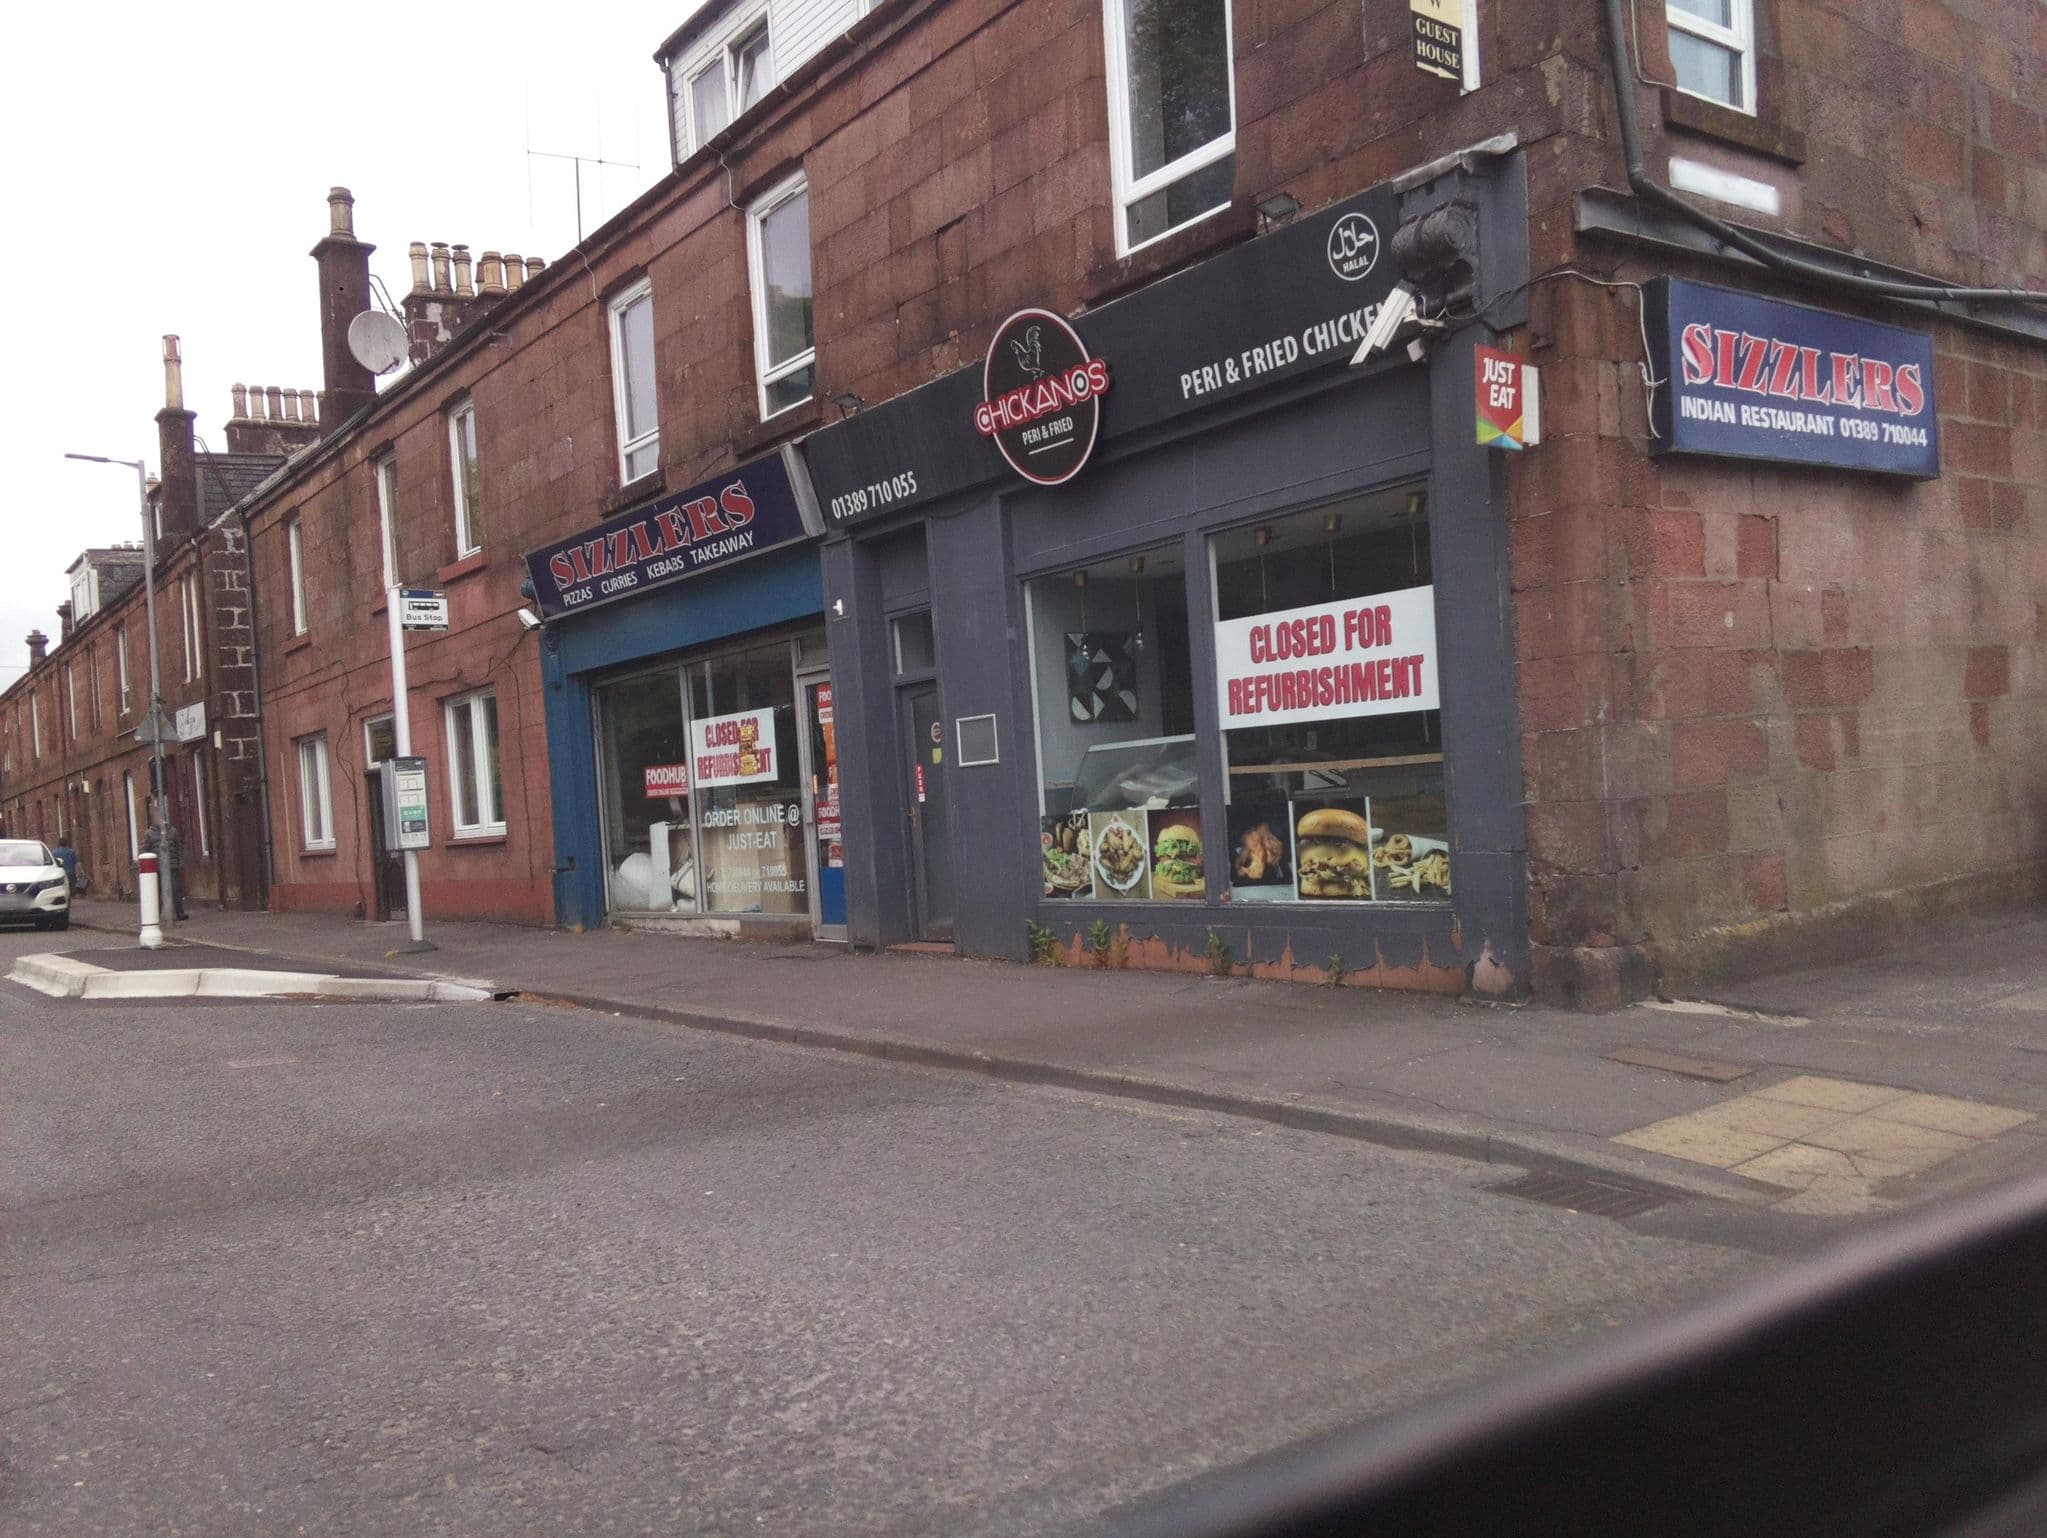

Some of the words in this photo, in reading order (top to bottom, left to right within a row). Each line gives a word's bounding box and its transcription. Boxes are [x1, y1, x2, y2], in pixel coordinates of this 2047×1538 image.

[1416, 18, 1458, 46] GUEST
[1416, 40, 1460, 69] HOUSE
[1343, 255, 1369, 273] HALAL
[1180, 363, 1222, 399] PERI
[1225, 357, 1241, 384] &
[1241, 335, 1299, 378] FRIED
[1303, 302, 1385, 356] CHICKE
[1482, 357, 1516, 385] JUST
[1681, 323, 1925, 417] SIZZLERS
[976, 362, 1107, 433] CHICKANOS
[1490, 384, 1516, 410] EAT
[1022, 428, 1041, 446] PERI
[1041, 425, 1050, 440] &
[1049, 416, 1074, 436] FRIED
[1681, 396, 1736, 424] INDIAN
[1741, 405, 1835, 436] RESTAURANT
[1840, 420, 1879, 441] 01389
[1882, 423, 1928, 447] 710044
[832, 489, 868, 519] 01389
[868, 481, 892, 508] 710
[892, 471, 917, 498] 055
[549, 479, 756, 592] SIZZLERS
[563, 586, 593, 608] PIZZAS
[601, 571, 638, 594] CURRIES
[646, 555, 685, 580] KEBABS
[690, 531, 754, 565] TAKEAWAY
[423, 614, 443, 622] Stop
[1250, 614, 1336, 663] CLOSED
[1343, 605, 1392, 651] FOR
[1228, 654, 1424, 716] REFURBISHMENT
[705, 721, 738, 748] CLOSED
[646, 766, 687, 785] FOODHUB
[704, 809, 741, 828] ORDER
[743, 804, 785, 825] ONLINE
[788, 804, 800, 827] @
[728, 831, 776, 849] JUST-EAT
[764, 880, 805, 892] AVAILABLE
